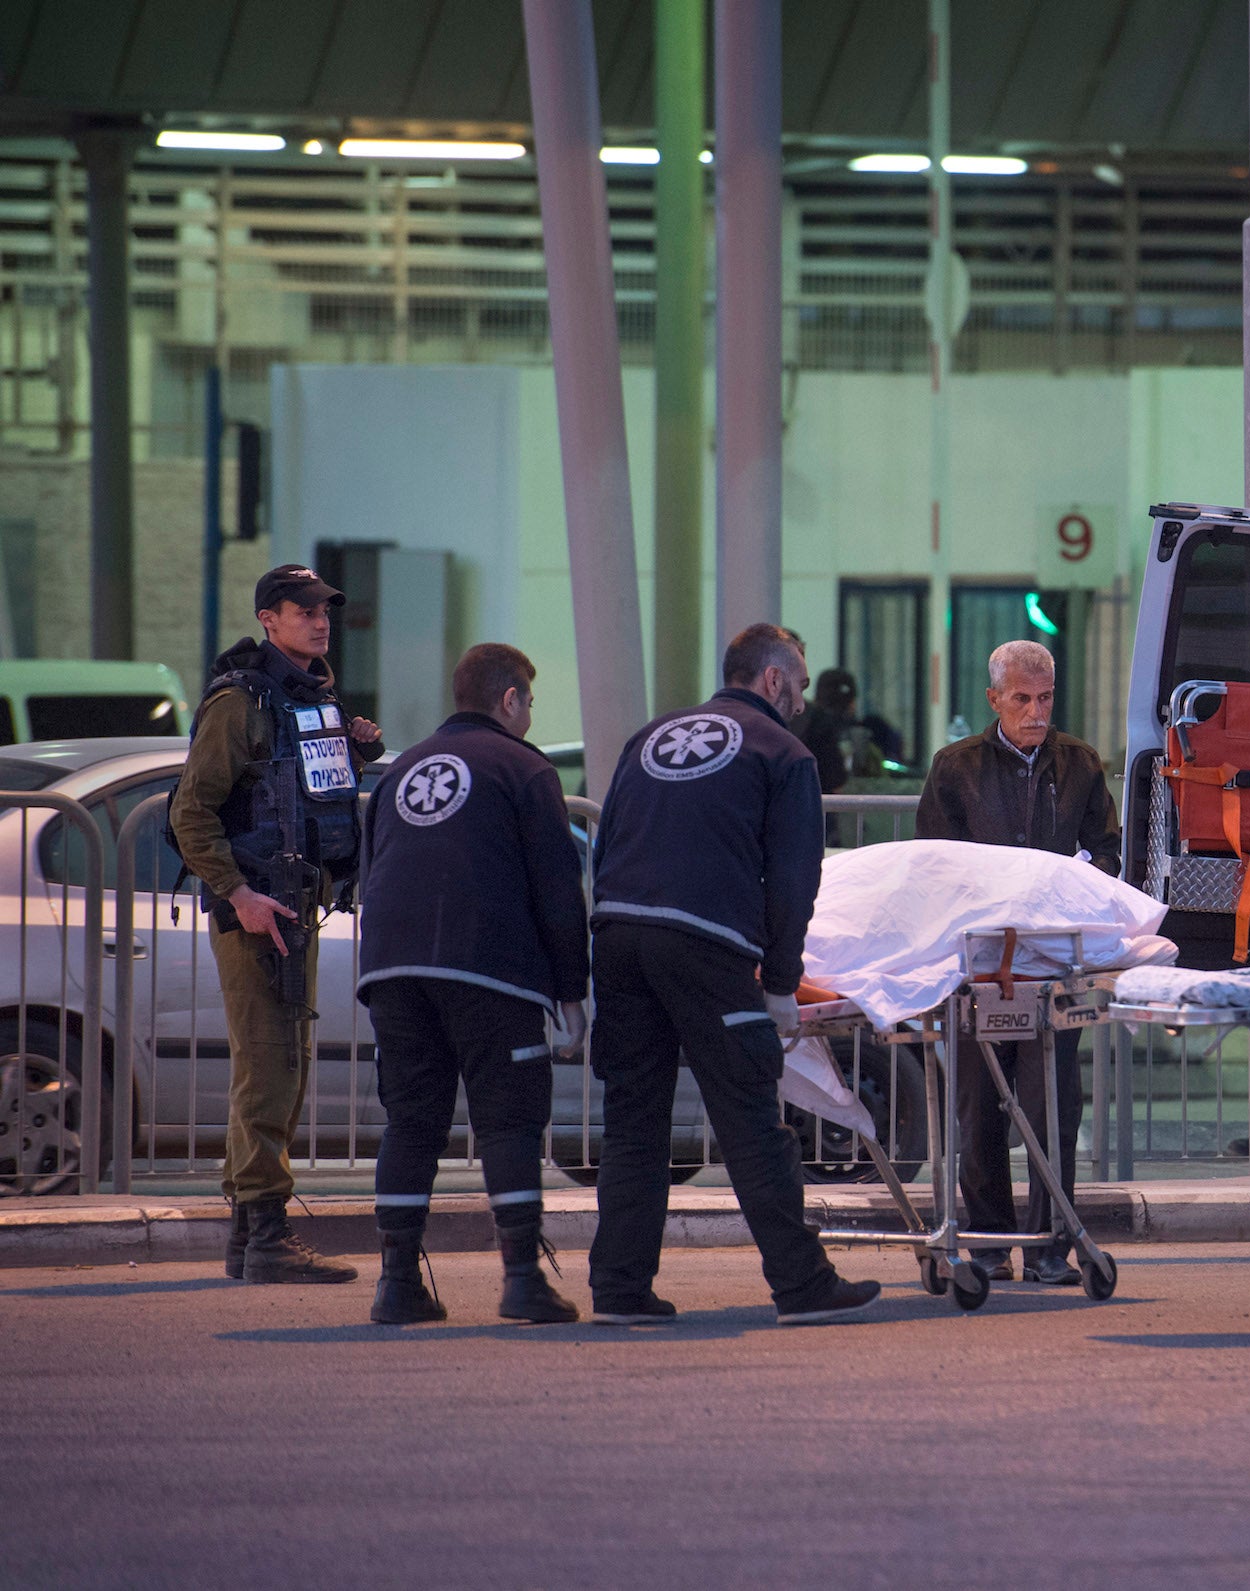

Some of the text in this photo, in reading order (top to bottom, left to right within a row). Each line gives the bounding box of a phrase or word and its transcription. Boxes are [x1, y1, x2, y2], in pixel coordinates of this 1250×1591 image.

[1058, 514, 1092, 562] 9
[303, 739, 347, 760] המשטרה
[311, 767, 351, 788] הצבאית
[987, 1013, 1030, 1028] FERNO
